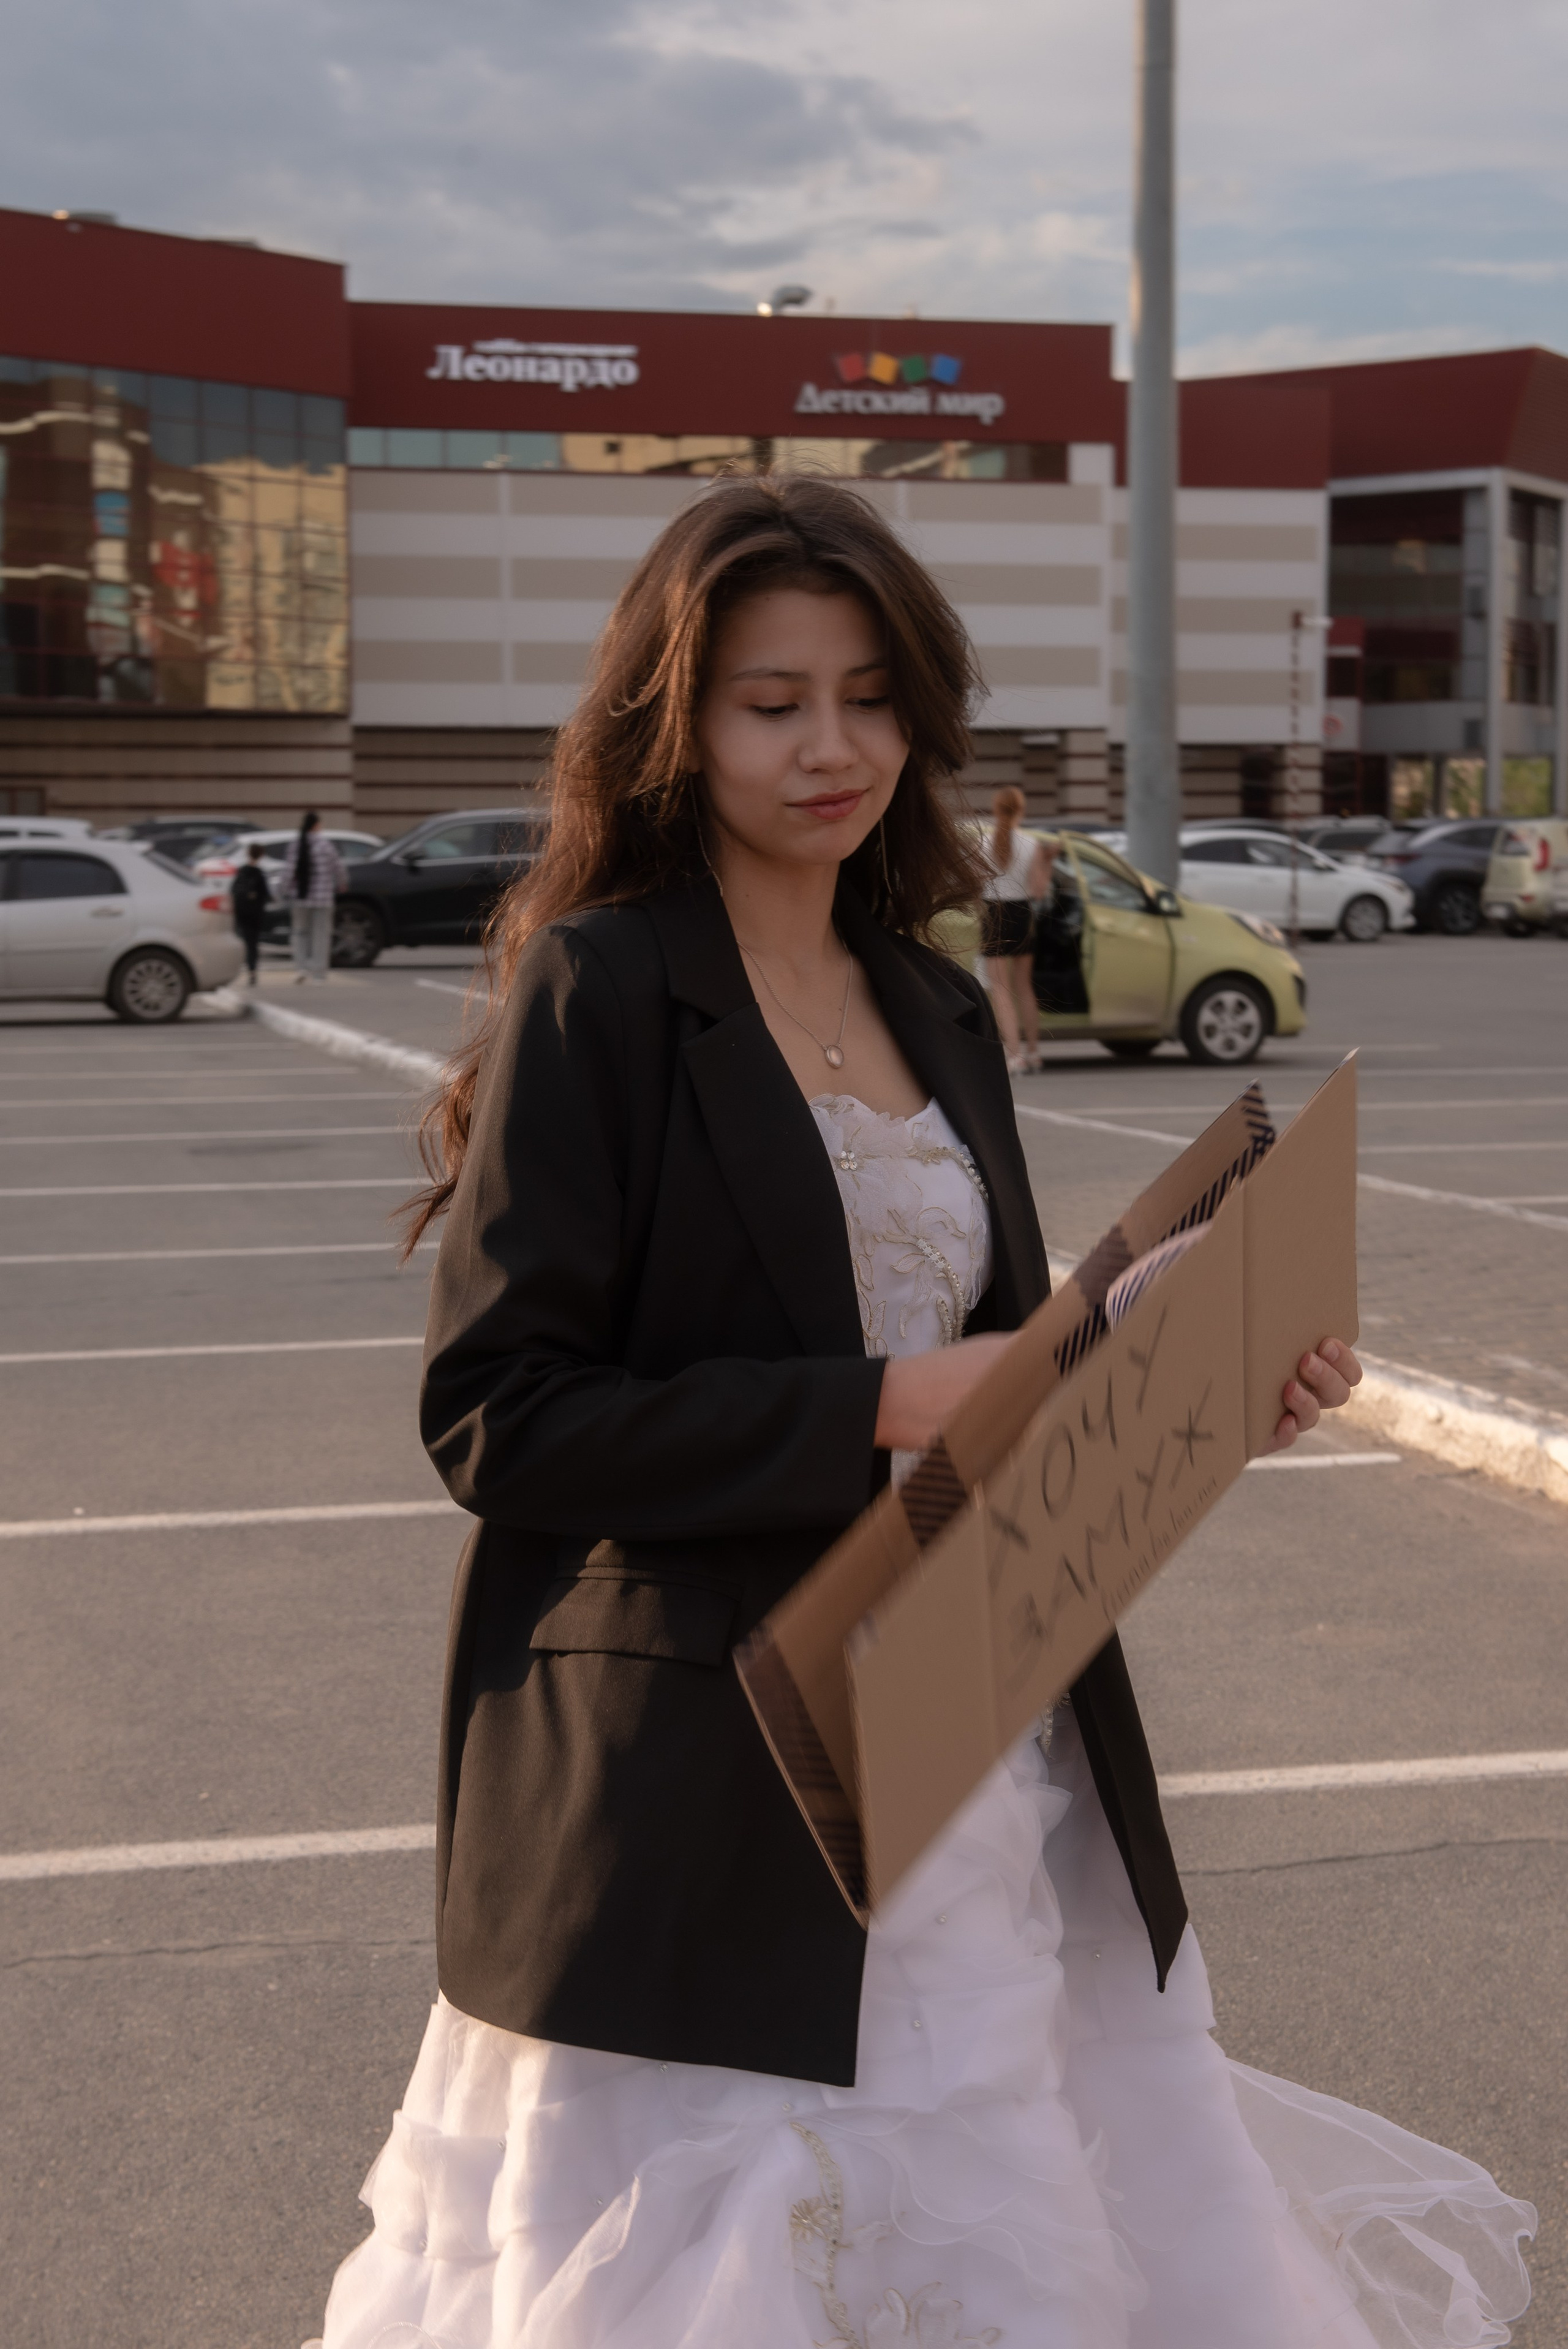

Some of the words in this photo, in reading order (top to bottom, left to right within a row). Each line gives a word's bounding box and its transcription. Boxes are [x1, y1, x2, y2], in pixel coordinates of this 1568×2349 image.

[426, 344, 640, 392] Леонардо
[794, 382, 932, 415] Детский
[933, 392, 1005, 426] мир
[986, 1294, 1171, 1597] ХОЧУ
[1003, 1375, 1216, 1701] ЗАМУЖ
